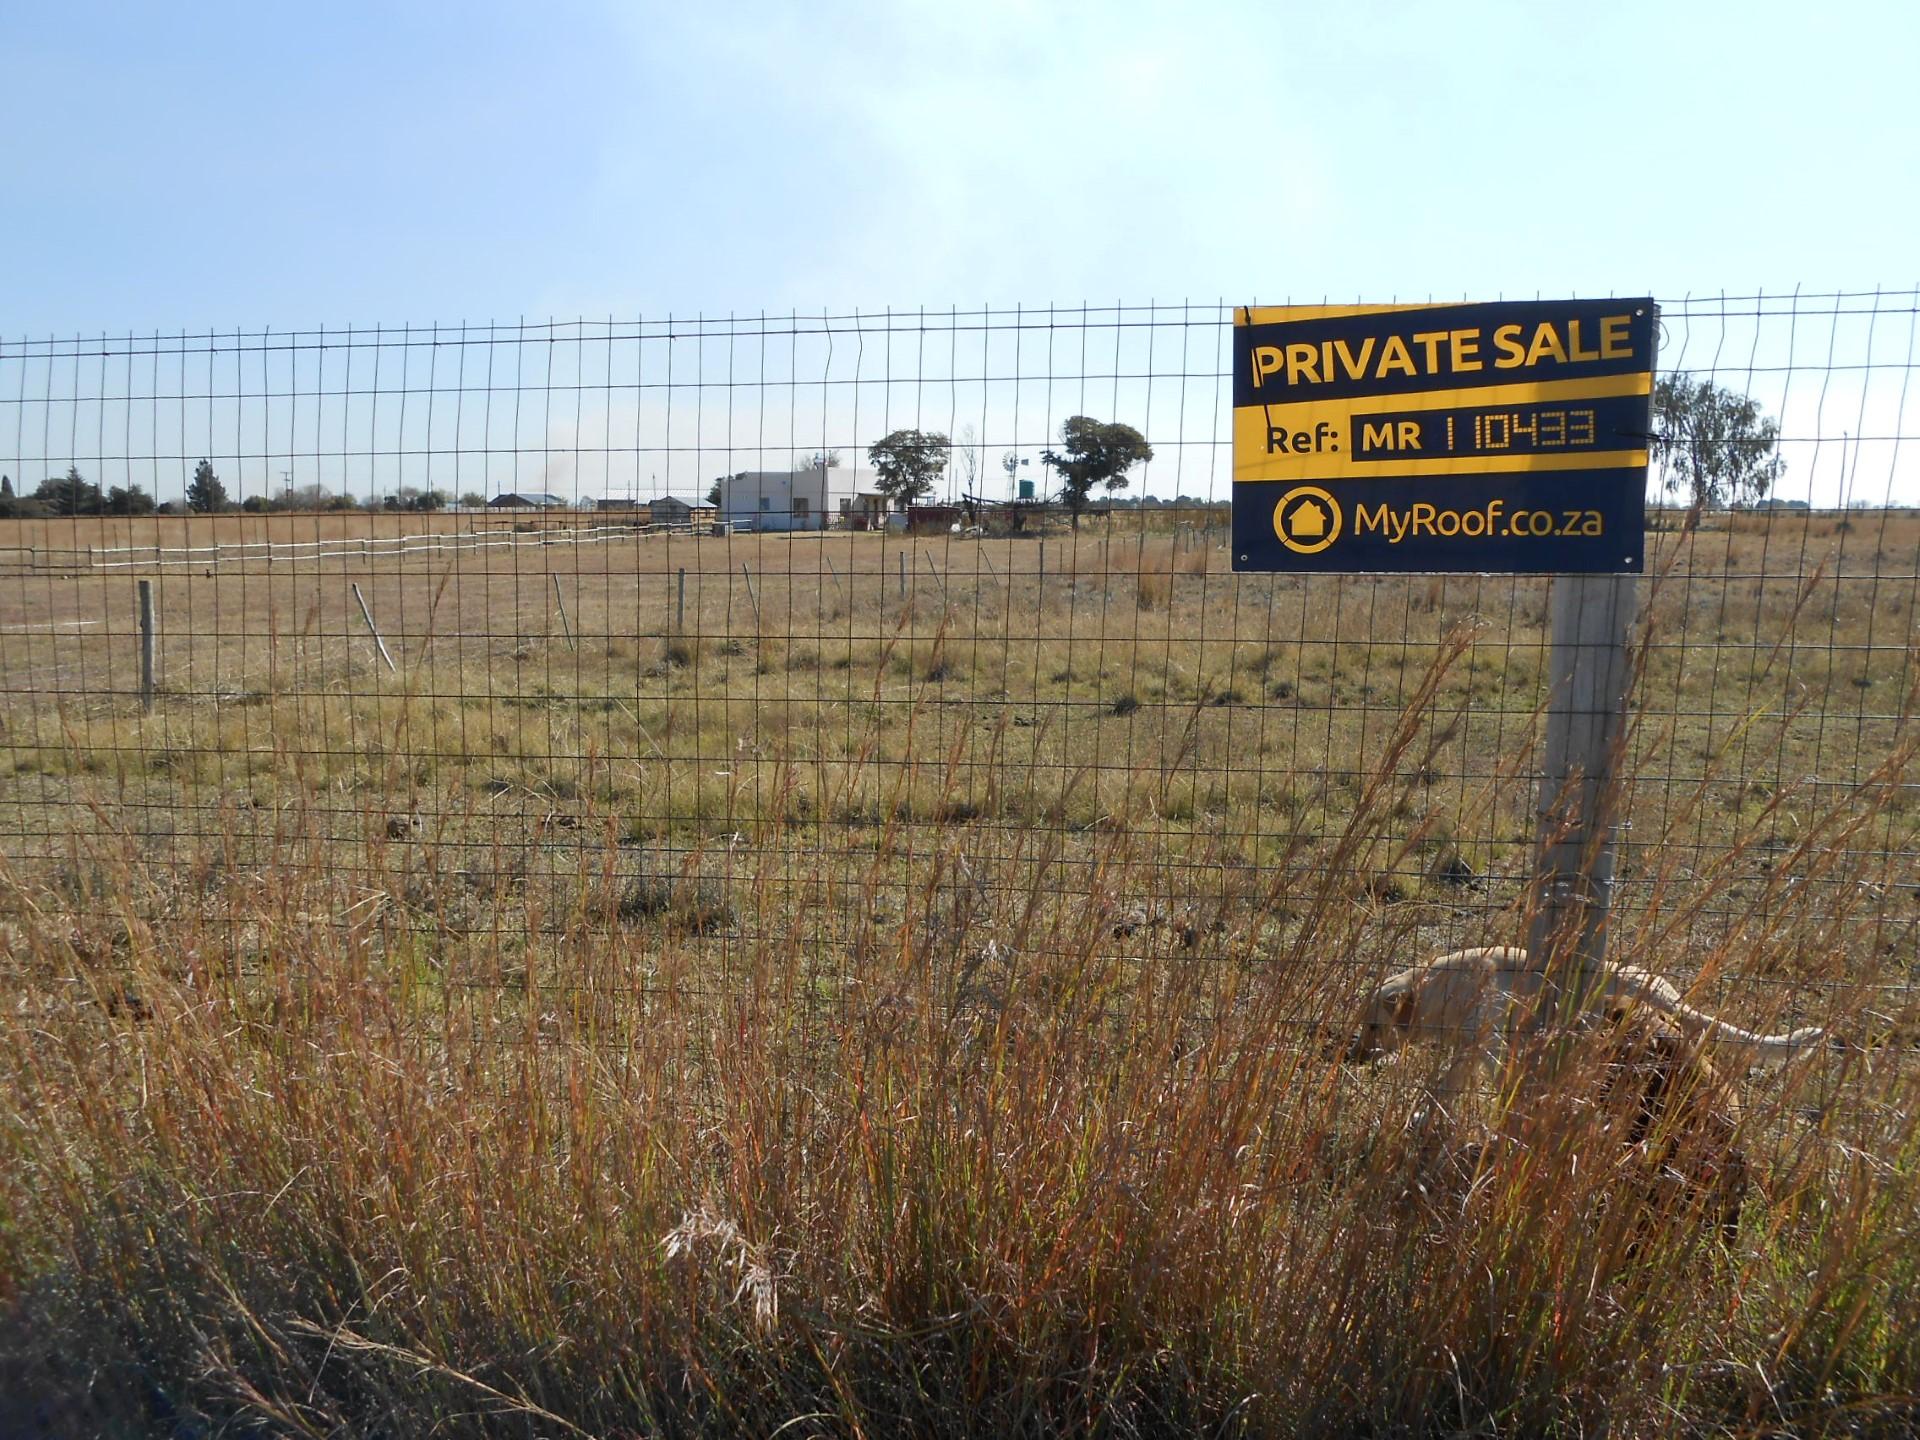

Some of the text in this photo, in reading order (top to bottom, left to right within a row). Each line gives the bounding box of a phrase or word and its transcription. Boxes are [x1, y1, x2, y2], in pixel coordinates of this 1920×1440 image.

[1252, 315, 1633, 388] PRIVATE SALE
[1266, 422, 1339, 454] Ref:
[1361, 422, 1423, 452] MR
[1354, 500, 1602, 543] MyRoof.co.za
